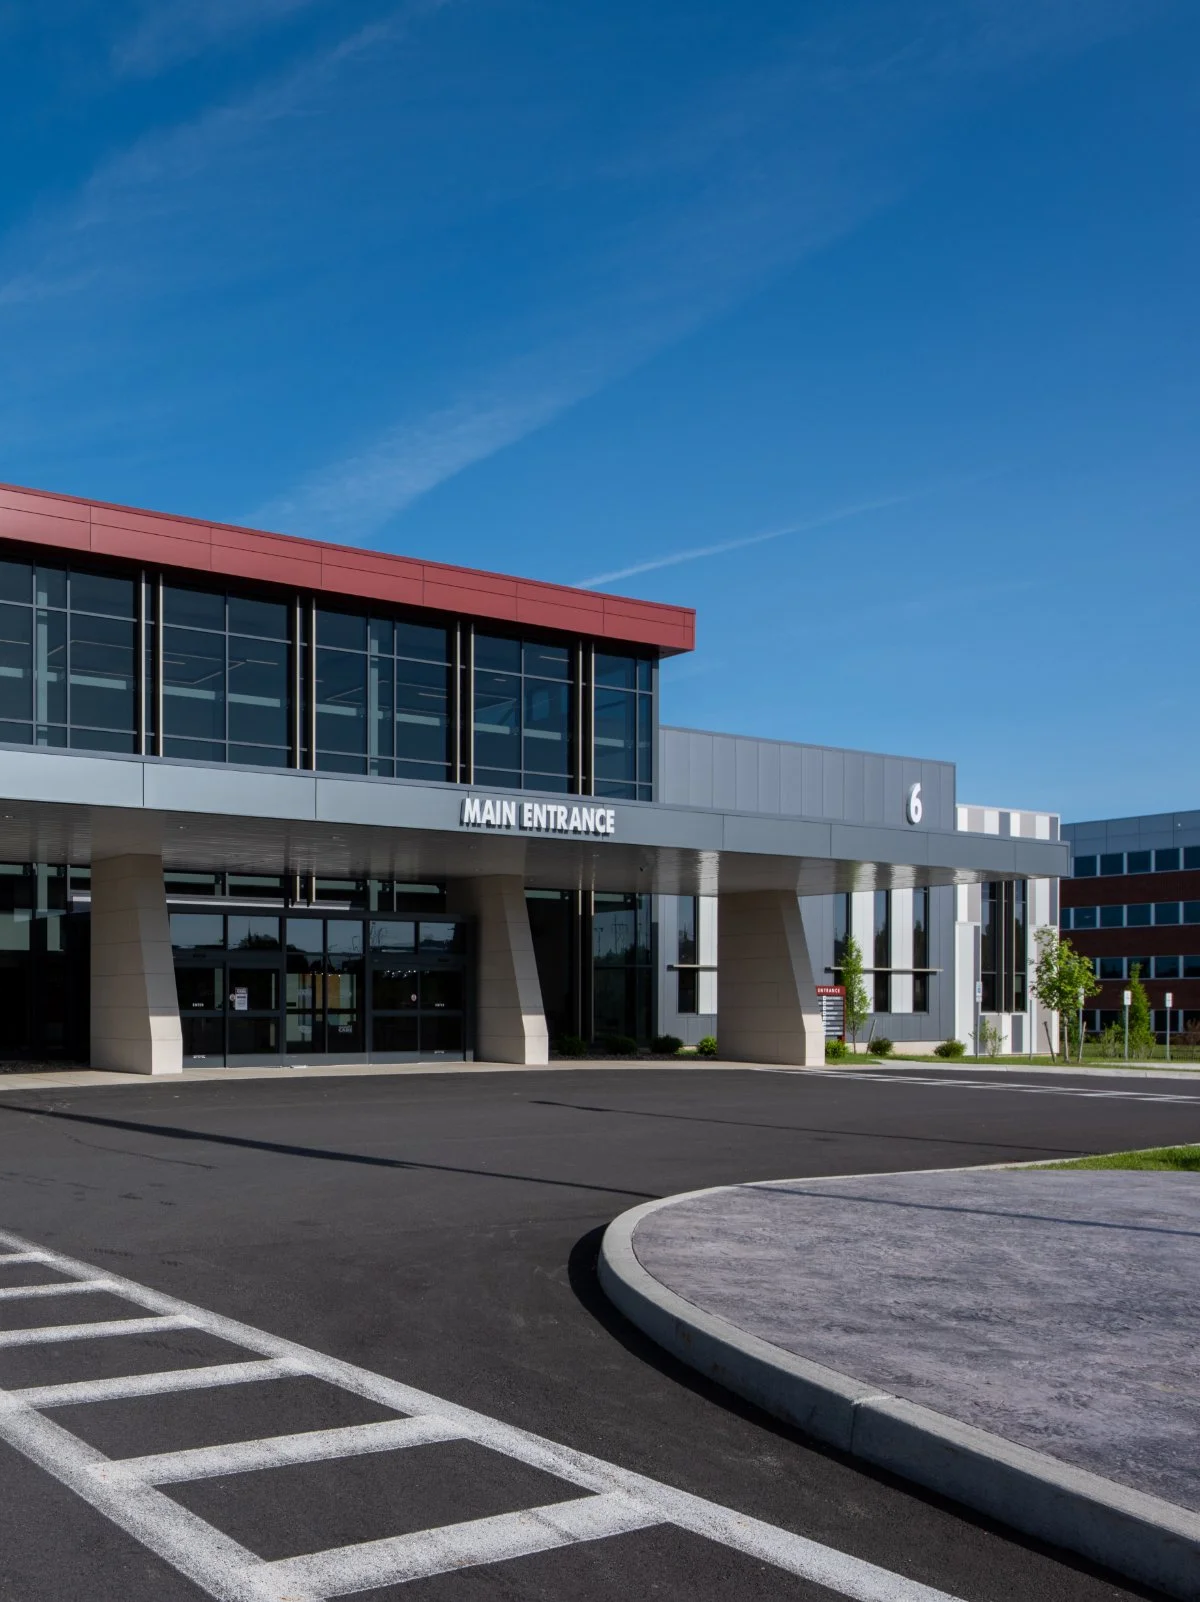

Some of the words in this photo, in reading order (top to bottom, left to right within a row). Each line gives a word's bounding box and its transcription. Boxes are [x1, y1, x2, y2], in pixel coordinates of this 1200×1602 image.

[463, 797, 516, 826] MAIN
[523, 802, 615, 834] ENTRANCE
[909, 782, 922, 823] 6
